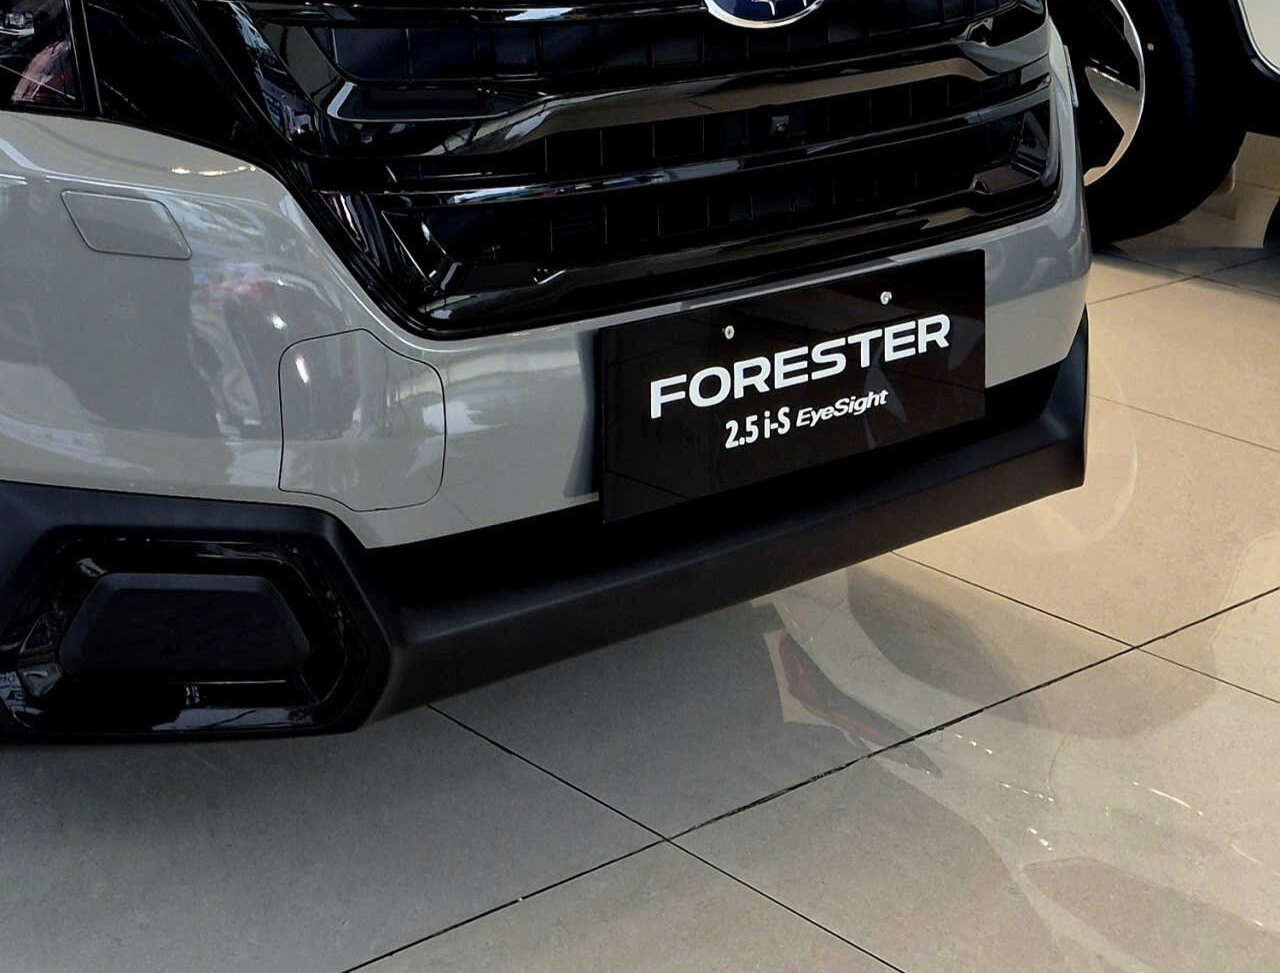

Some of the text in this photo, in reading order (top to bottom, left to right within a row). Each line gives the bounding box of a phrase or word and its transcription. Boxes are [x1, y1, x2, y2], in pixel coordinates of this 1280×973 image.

[650, 314, 951, 419] FORESTER
[725, 389, 888, 449] 2.5 i-S EyeSight
